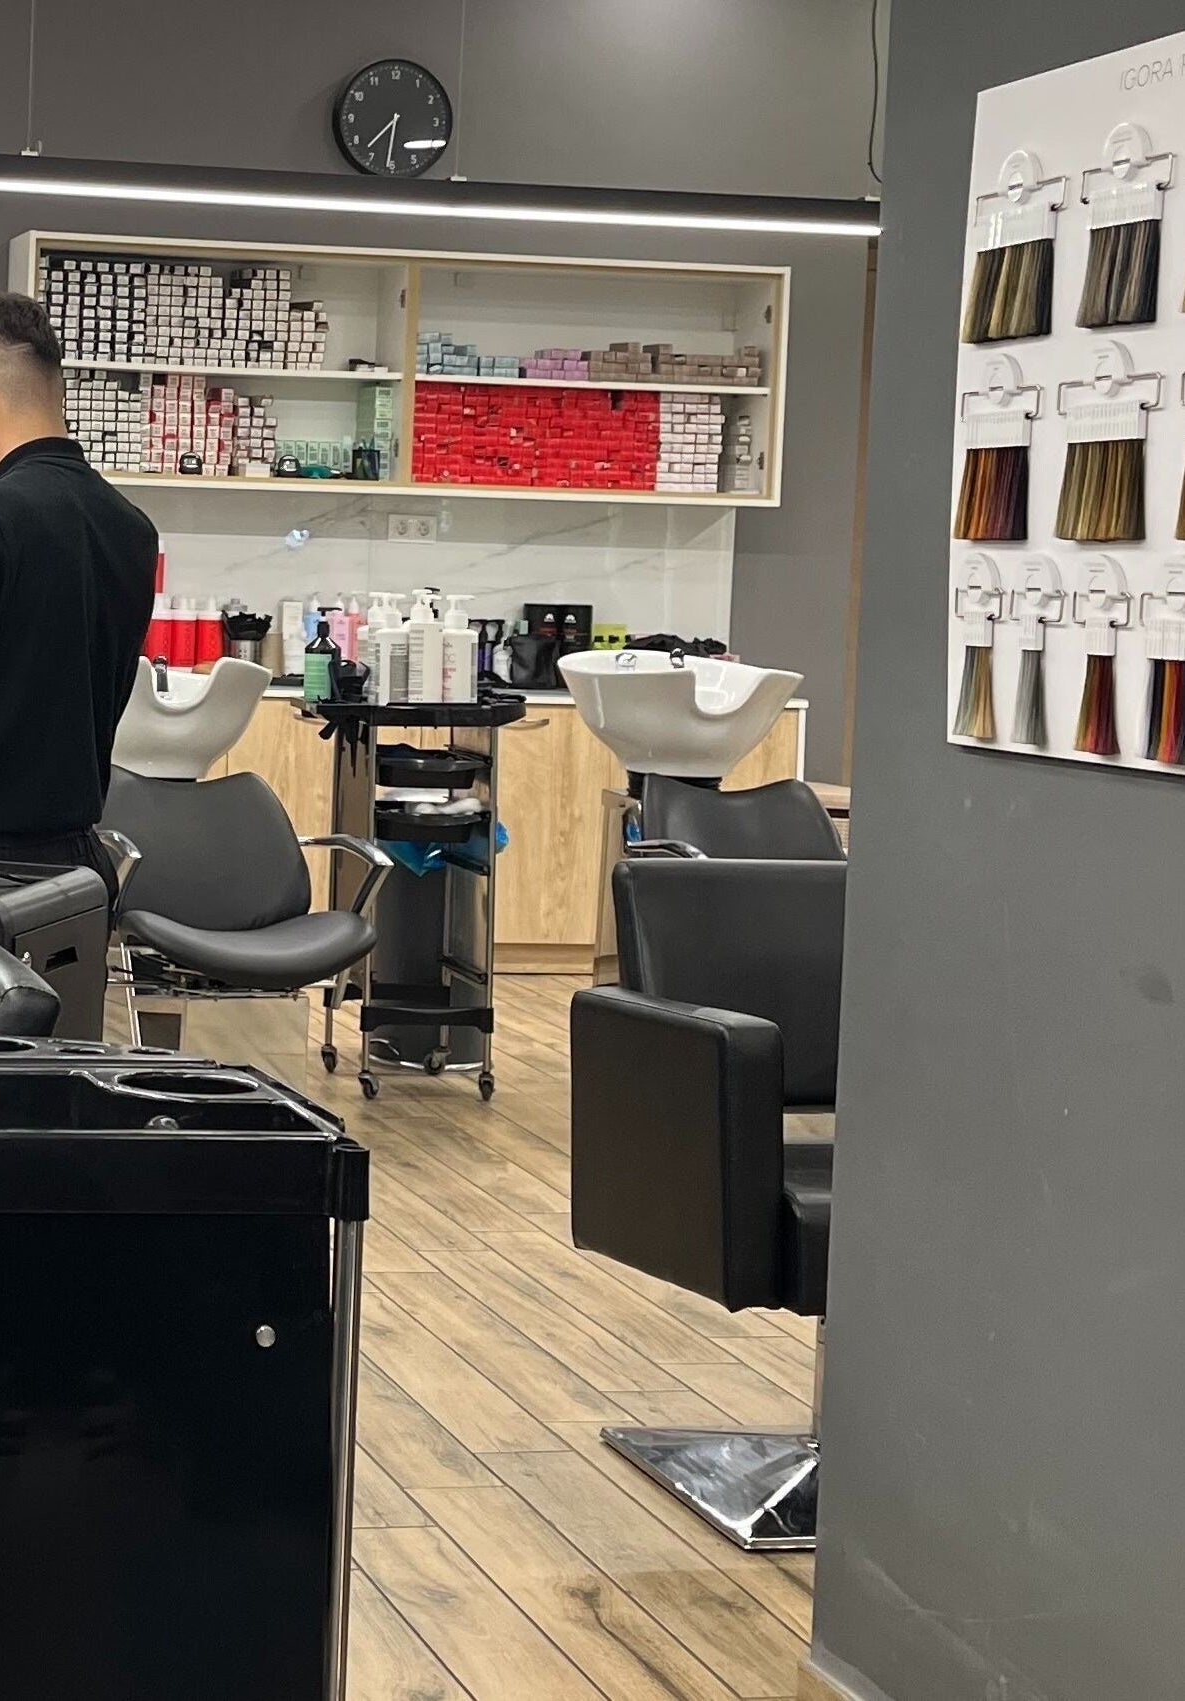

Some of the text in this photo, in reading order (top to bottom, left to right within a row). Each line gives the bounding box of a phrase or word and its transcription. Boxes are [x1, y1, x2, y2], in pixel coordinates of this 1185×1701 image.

[391, 70, 401, 80] 12
[1119, 57, 1174, 92] IGORA
[370, 76, 379, 86] 11
[354, 91, 364, 101] 10
[428, 95, 434, 104] 2
[347, 114, 355, 123] 9
[433, 117, 439, 127] 3
[353, 135, 360, 145] 8
[368, 152, 375, 162] 7
[410, 154, 417, 165] 5
